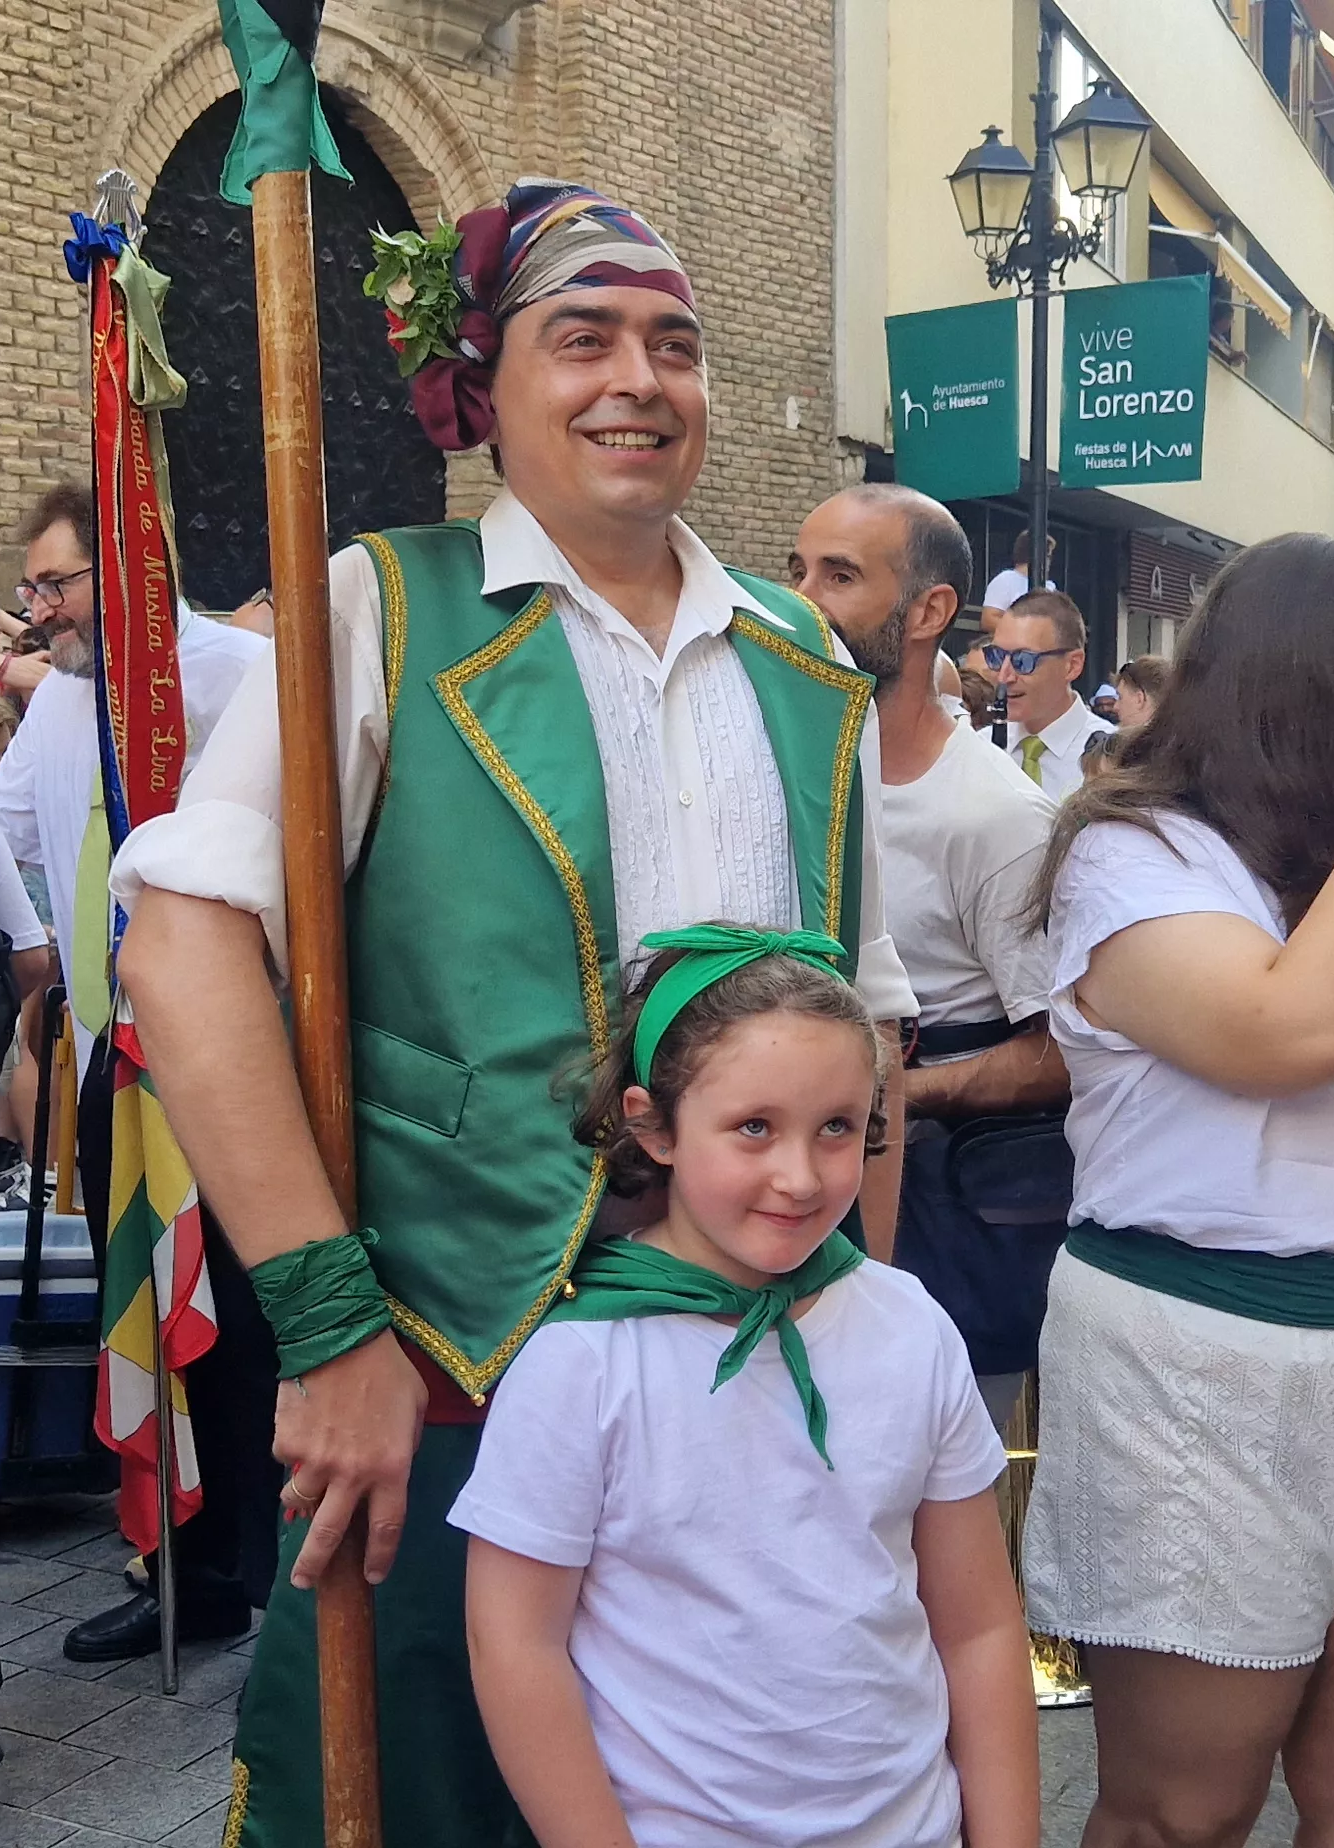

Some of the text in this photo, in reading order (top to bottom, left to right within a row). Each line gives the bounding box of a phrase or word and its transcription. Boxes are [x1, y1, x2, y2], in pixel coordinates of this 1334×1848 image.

[1079, 321, 1133, 353] vive
[1079, 355, 1133, 387] San
[932, 377, 1006, 400] Ayuntamiento
[932, 394, 989, 412] de Huesca
[1079, 387, 1195, 420] Lorenzo
[129, 405, 152, 491] Banda
[1074, 440, 1128, 457] fiestas de
[1085, 456, 1128, 471] Huesca
[138, 501, 159, 536] de
